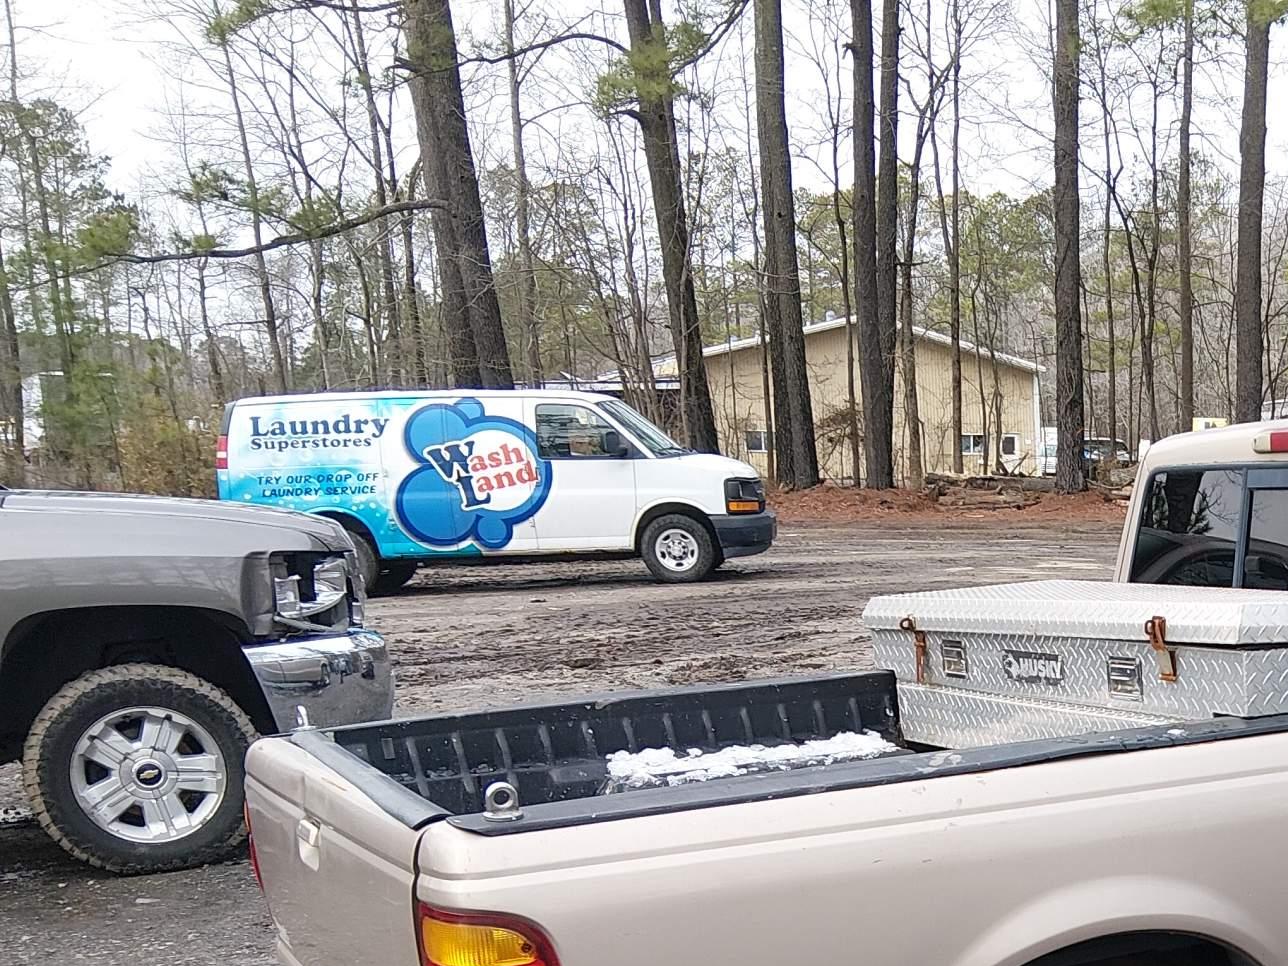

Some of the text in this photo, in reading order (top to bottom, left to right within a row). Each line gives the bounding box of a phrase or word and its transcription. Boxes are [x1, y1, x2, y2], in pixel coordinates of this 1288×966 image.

[250, 414, 390, 438] Laundry
[250, 437, 372, 452] Superstores
[427, 441, 525, 479] Wash
[257, 472, 380, 486] TRY OUR DROP OFF
[457, 461, 539, 508] Land
[262, 485, 377, 498] LAUNDRY SERVICE
[1019, 658, 1062, 679] HUSKY
